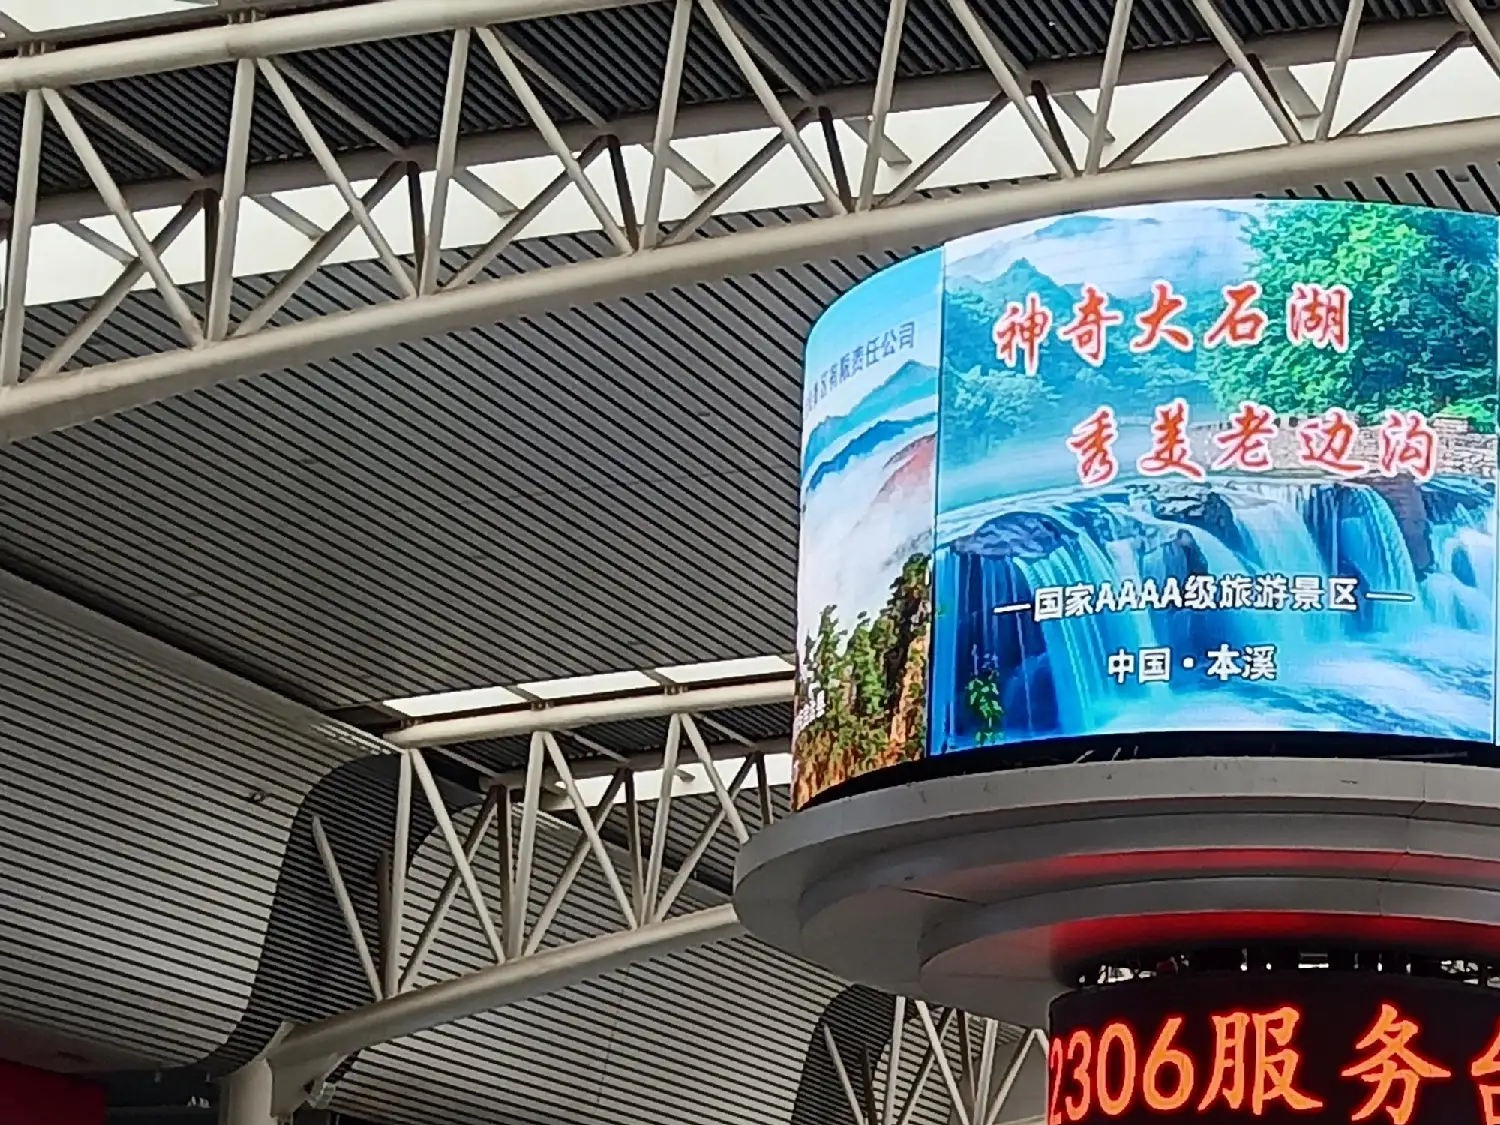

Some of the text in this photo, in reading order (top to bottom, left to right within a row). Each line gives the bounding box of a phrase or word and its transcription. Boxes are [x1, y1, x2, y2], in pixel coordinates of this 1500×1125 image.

[993, 279, 1353, 376] 神奇大石湖
[1066, 397, 1438, 485] 秀美老边沟
